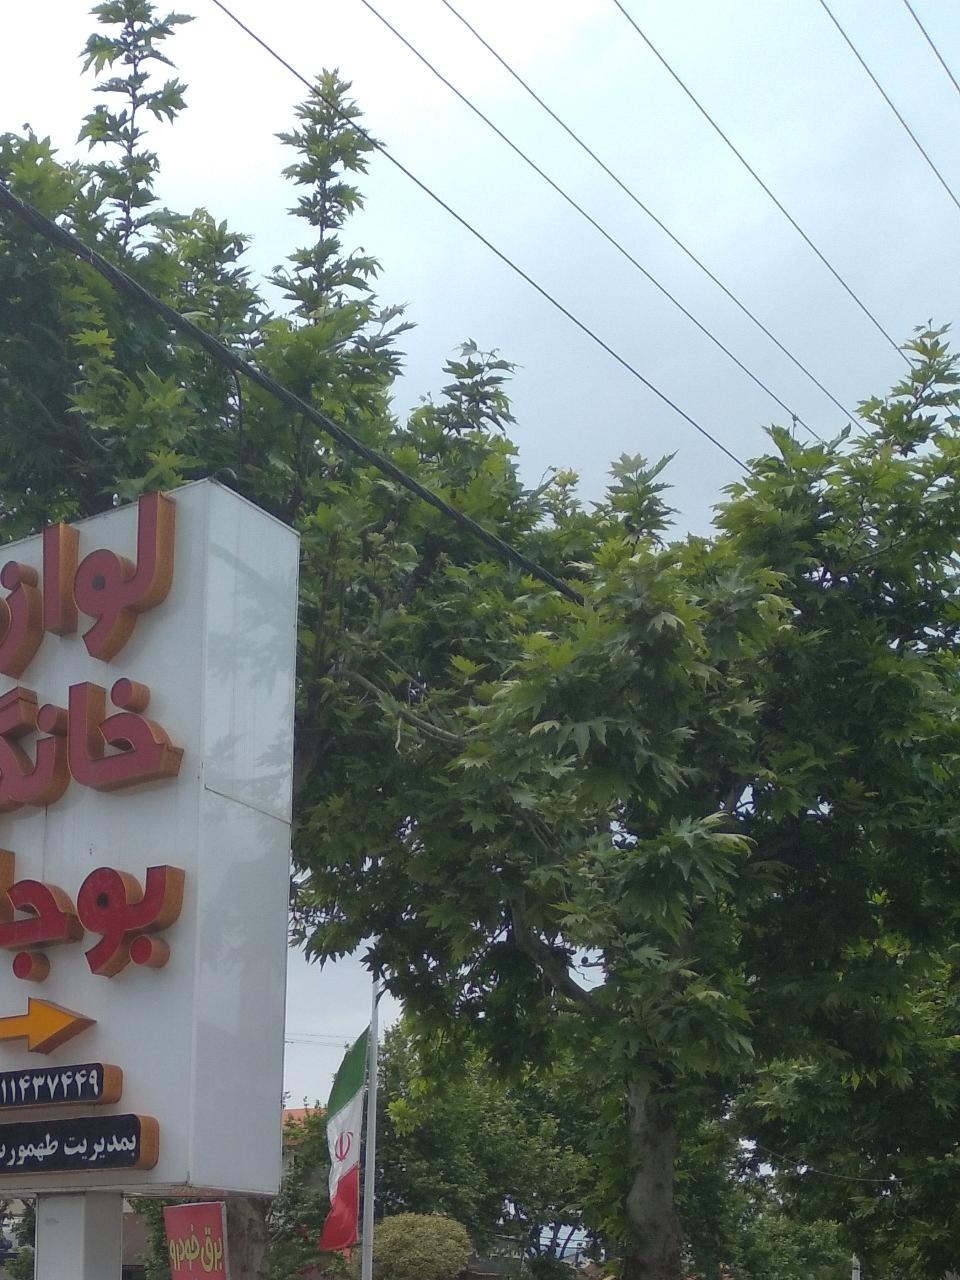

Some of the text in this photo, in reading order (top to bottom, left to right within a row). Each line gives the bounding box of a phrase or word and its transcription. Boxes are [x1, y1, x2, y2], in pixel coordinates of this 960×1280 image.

[63, 1134, 137, 1161] بمدیریت
[170, 1223, 223, 1272] برق خودرو
